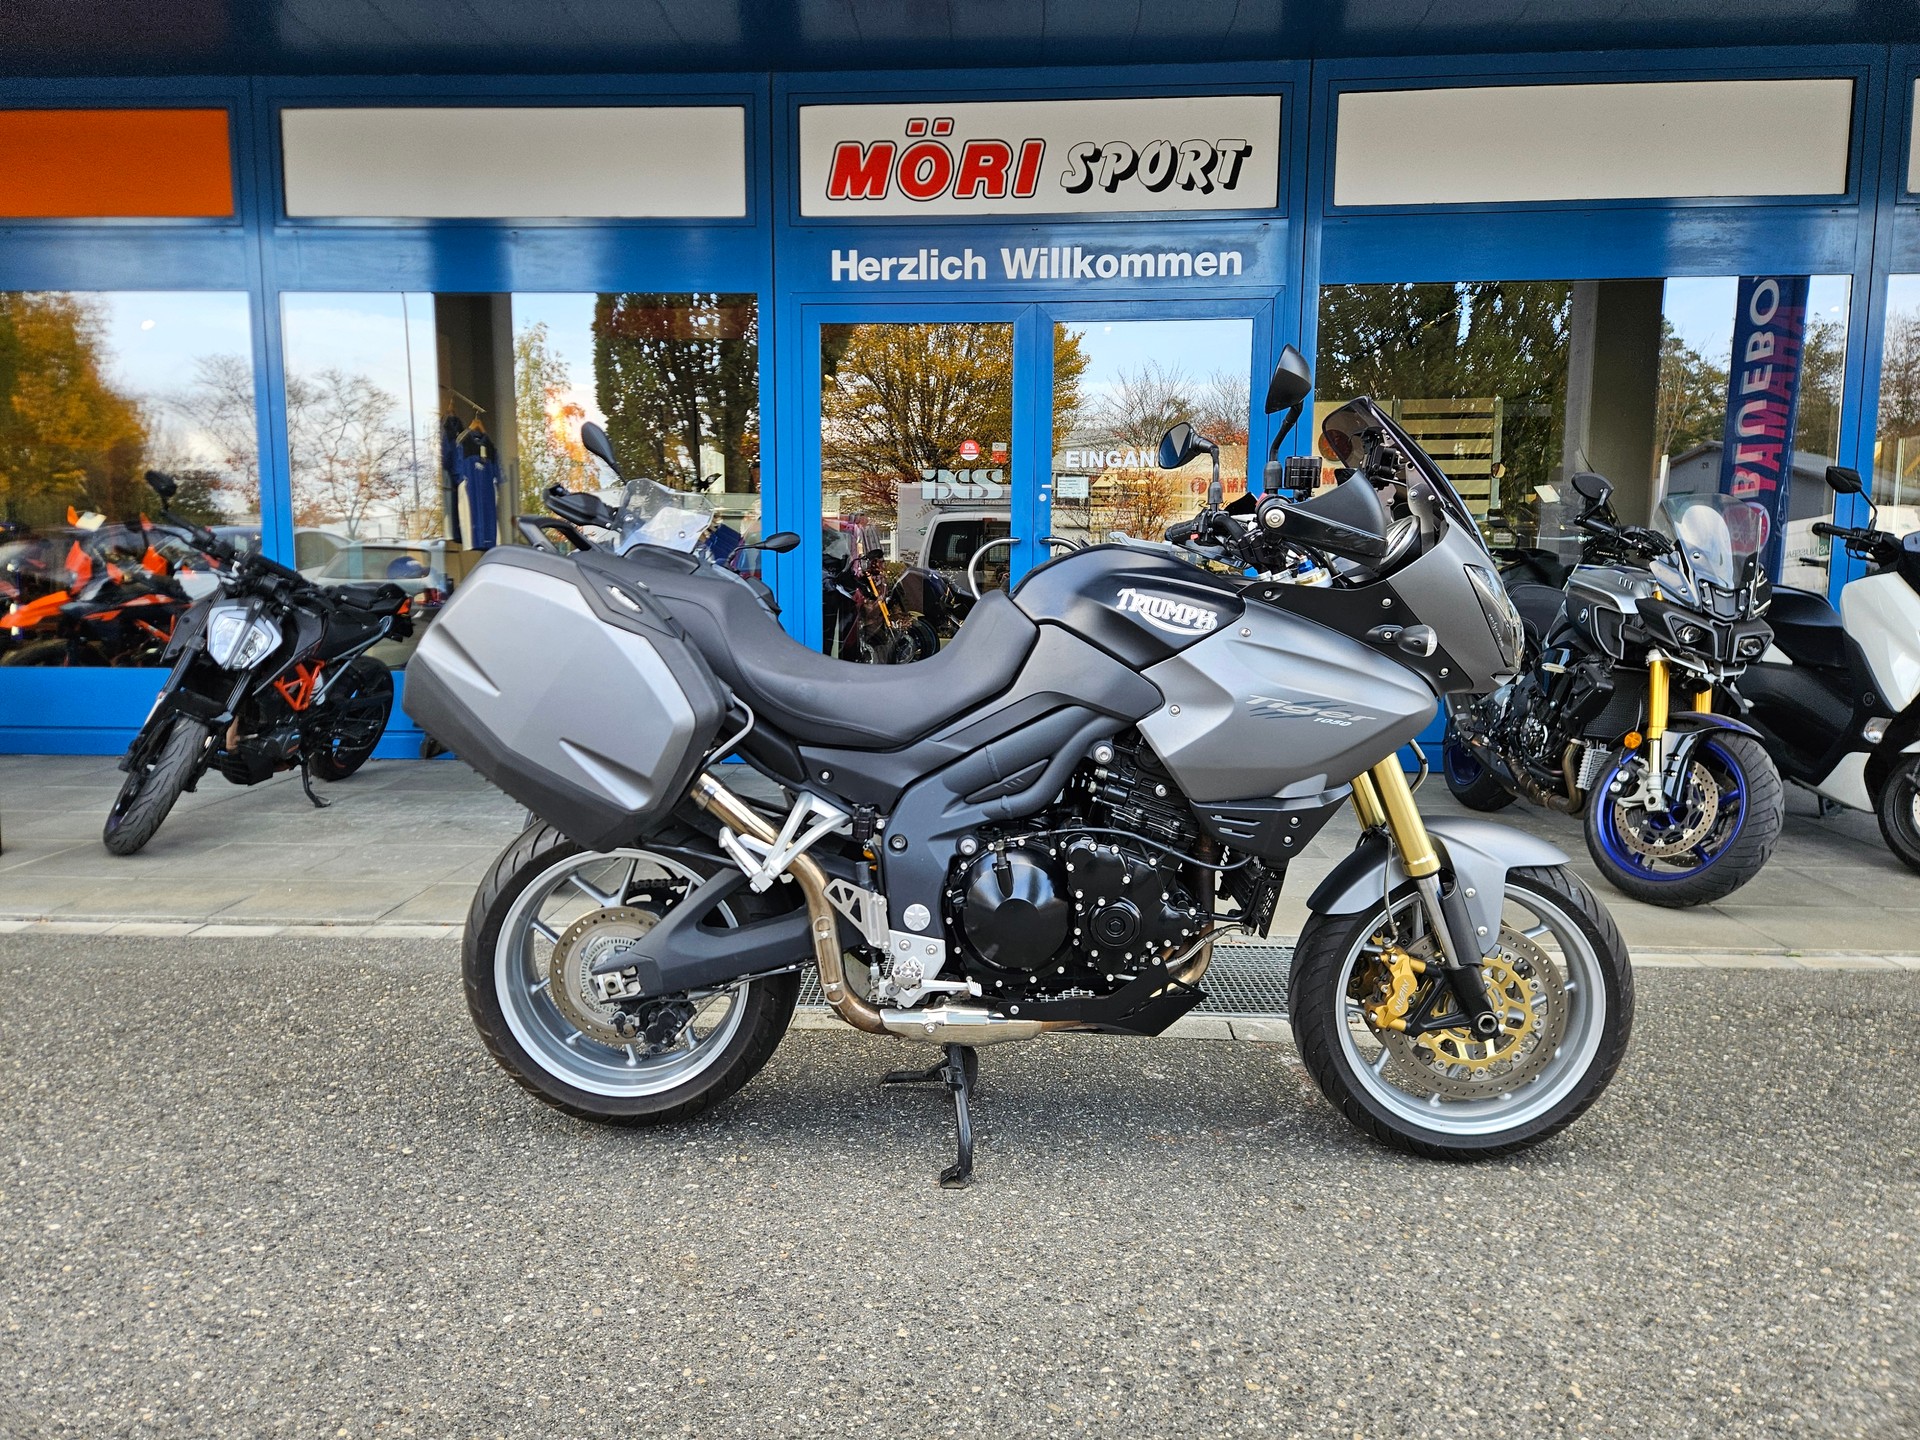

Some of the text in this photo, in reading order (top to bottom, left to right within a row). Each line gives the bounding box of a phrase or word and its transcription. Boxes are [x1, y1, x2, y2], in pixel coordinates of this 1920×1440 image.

[825, 117, 1252, 201] MÖRI SPORT
[830, 245, 1243, 282] Herzlich Willkommen
[964, 442, 975, 450] 0%
[1065, 450, 1156, 468] EINGAN
[1116, 588, 1217, 630] TRIUMPH
[1246, 694, 1377, 721] Tiger
[1313, 717, 1352, 727] 1050
